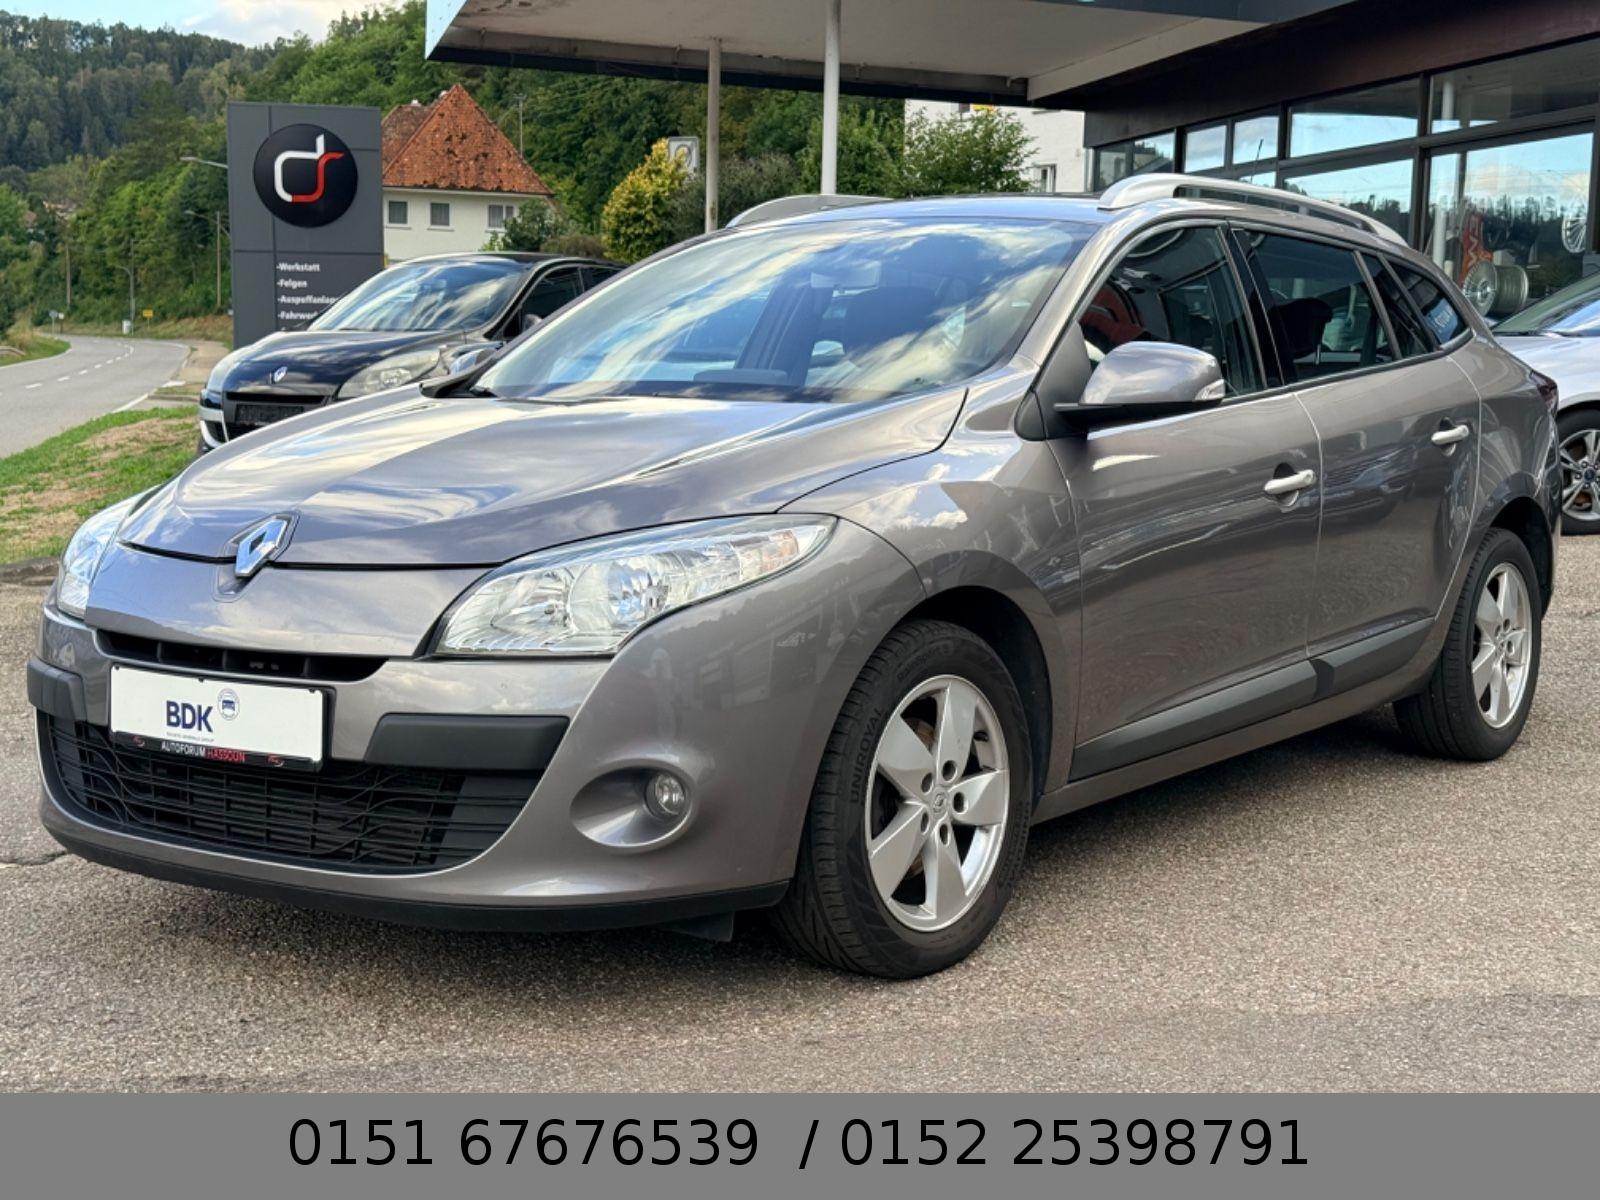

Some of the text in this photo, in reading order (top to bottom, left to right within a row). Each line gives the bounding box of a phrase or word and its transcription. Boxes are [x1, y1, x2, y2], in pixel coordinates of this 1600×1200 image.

[277, 278, 308, 290] -Felgen
[277, 295, 339, 306] -Auspuffanlag
[166, 700, 214, 733] BDK
[161, 741, 206, 757] AUTOFORUM
